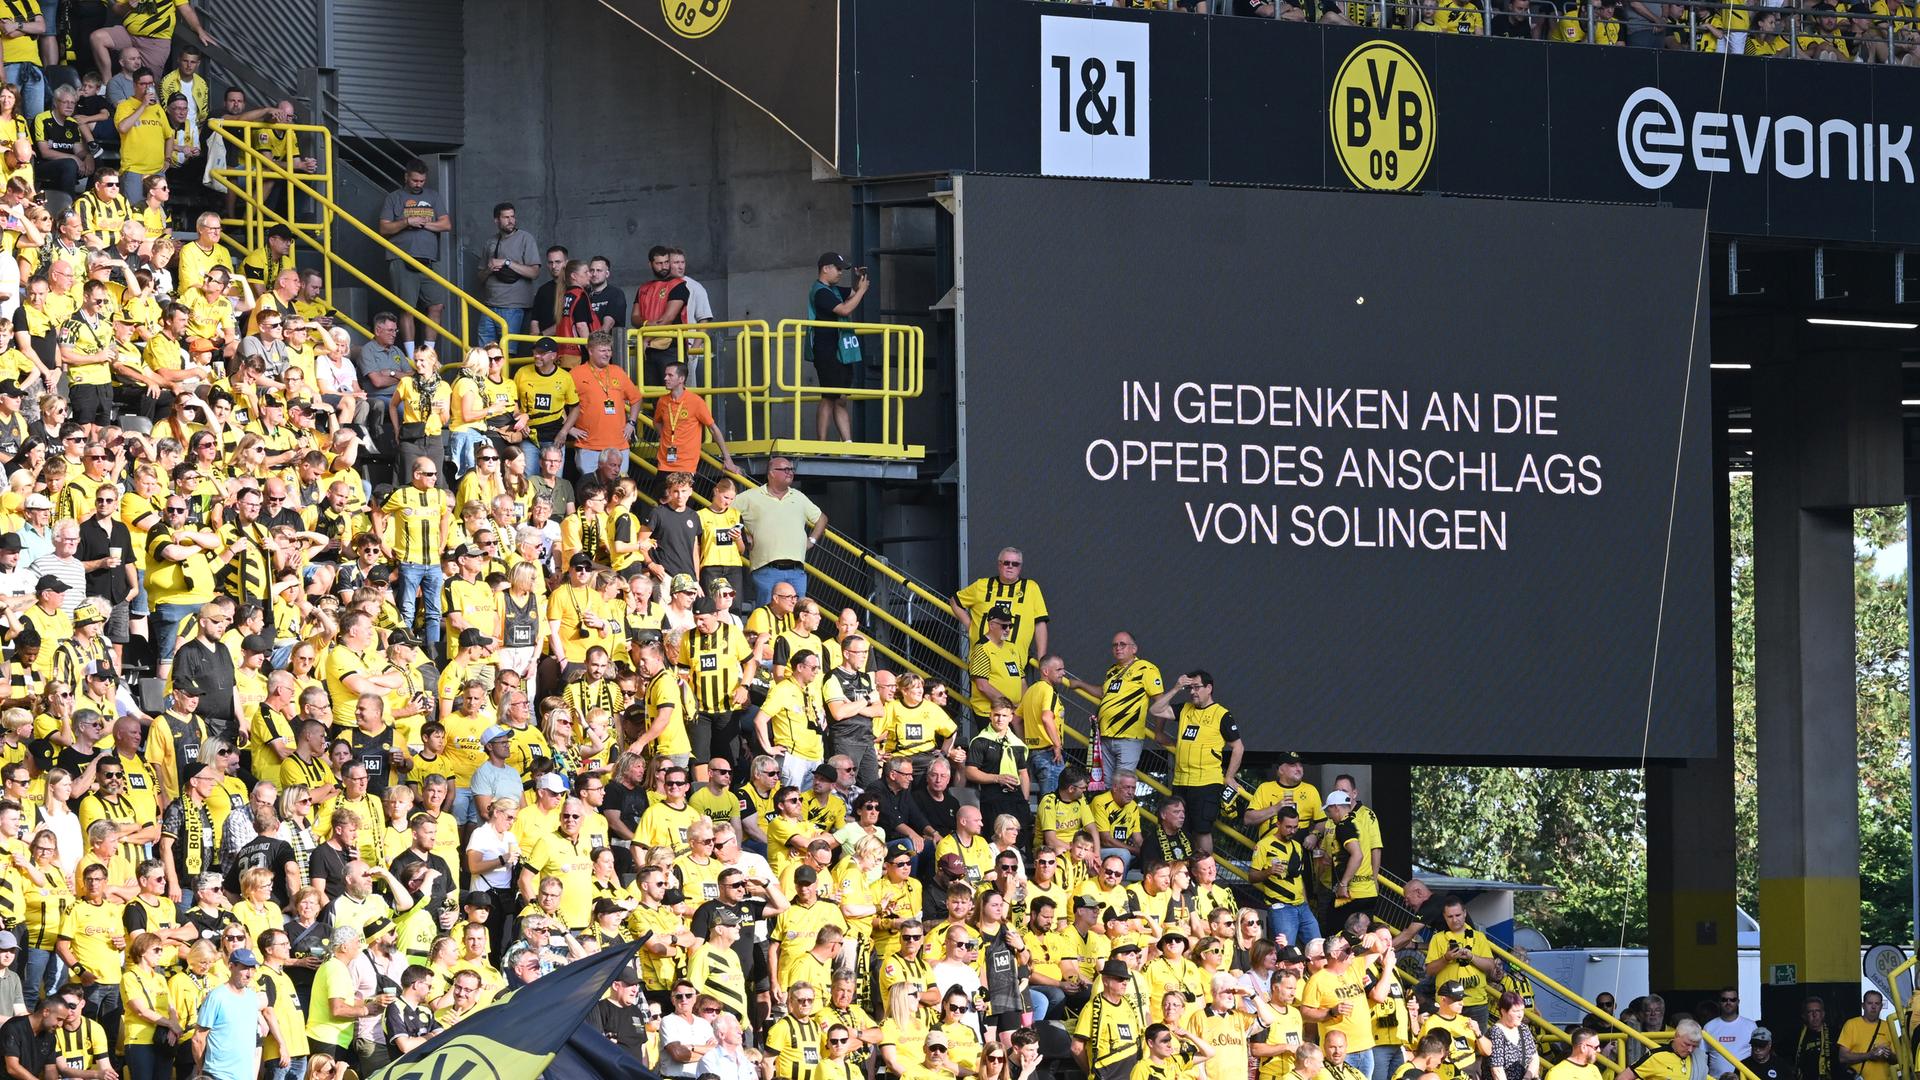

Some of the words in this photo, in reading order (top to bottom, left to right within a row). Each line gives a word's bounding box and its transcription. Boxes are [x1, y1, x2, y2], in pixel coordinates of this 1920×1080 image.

[675, 2, 696, 27] 09
[1051, 55, 1136, 137] 1&1
[1346, 58, 1423, 151] BVB
[1691, 111, 1915, 184] EVONIK
[1369, 149, 1398, 181] 09
[536, 396, 550, 407] 1&1
[1122, 380, 1160, 422] IN
[1173, 381, 1409, 430] GEDENKEN
[1421, 391, 1480, 433] AN
[1493, 393, 1558, 436] DIE
[1085, 438, 1228, 484] OPFER
[1241, 444, 1324, 488] DES
[1335, 447, 1602, 496] ANSCHLAGS
[1185, 501, 1278, 545] VON
[1290, 504, 1507, 551] SOLINGEN
[516, 629, 529, 640] 1&1
[701, 657, 716, 668] 1&1
[906, 726, 922, 736] 1&1
[1184, 727, 1198, 738] 1&1
[364, 759, 380, 770] 1&1
[129, 776, 145, 787] 1&1
[1222, 786, 1235, 801] 1&1
[1114, 830, 1125, 839] 1&1
[996, 955, 1009, 966] 1&1
[67, 1060, 83, 1069] 1&1
